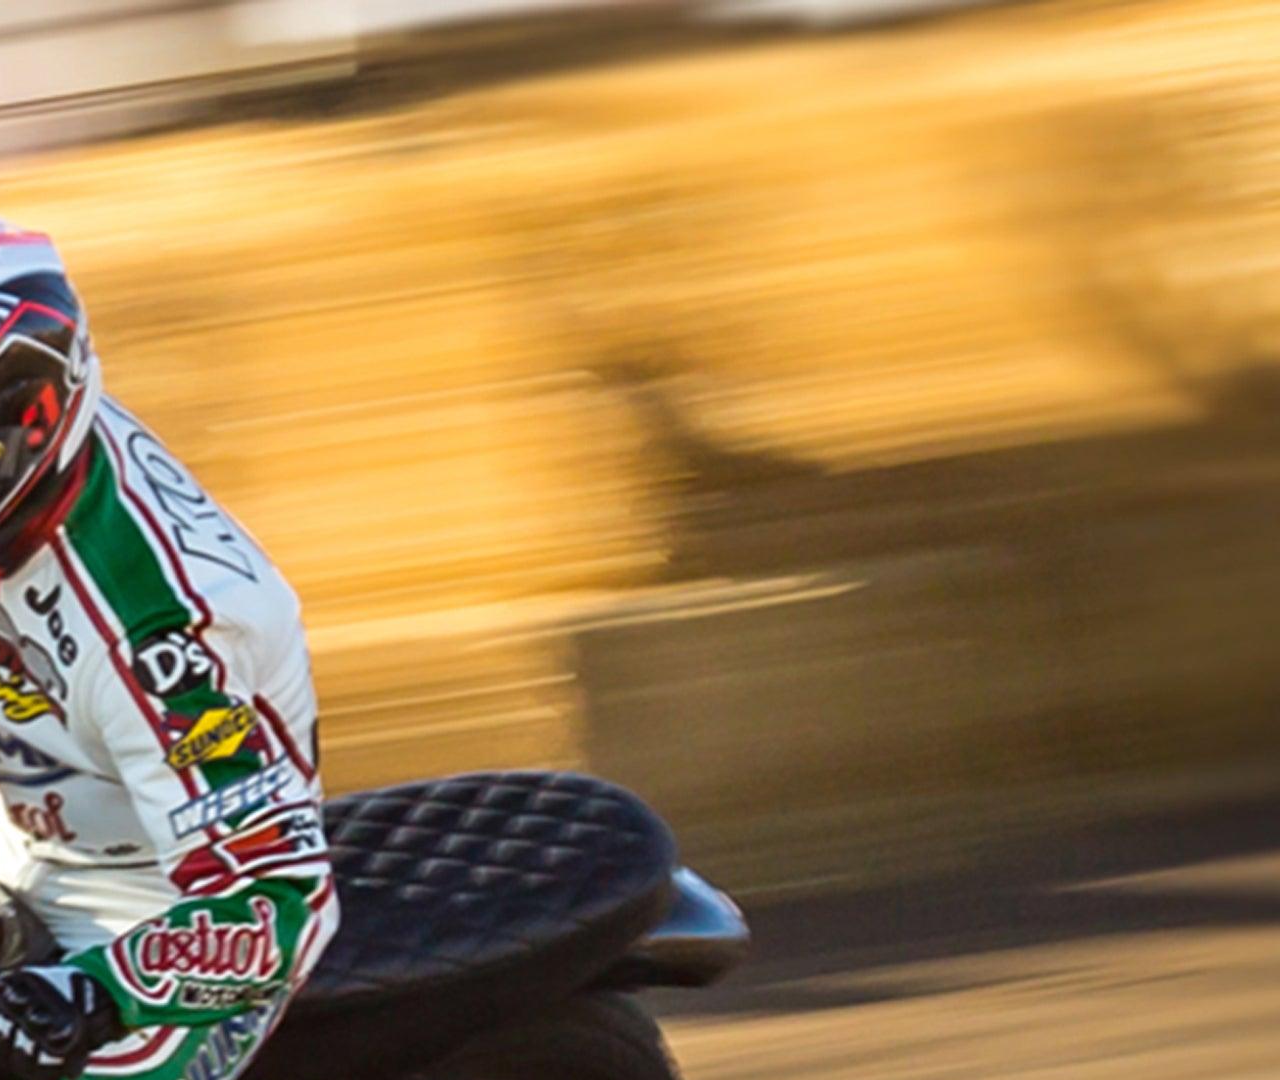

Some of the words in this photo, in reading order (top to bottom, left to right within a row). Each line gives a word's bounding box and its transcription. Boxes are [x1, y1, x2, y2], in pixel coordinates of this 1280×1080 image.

[25, 584, 78, 667] Joe
[138, 632, 212, 693] D's
[169, 752, 294, 840] WISEC
[108, 896, 281, 1004] Castrol
